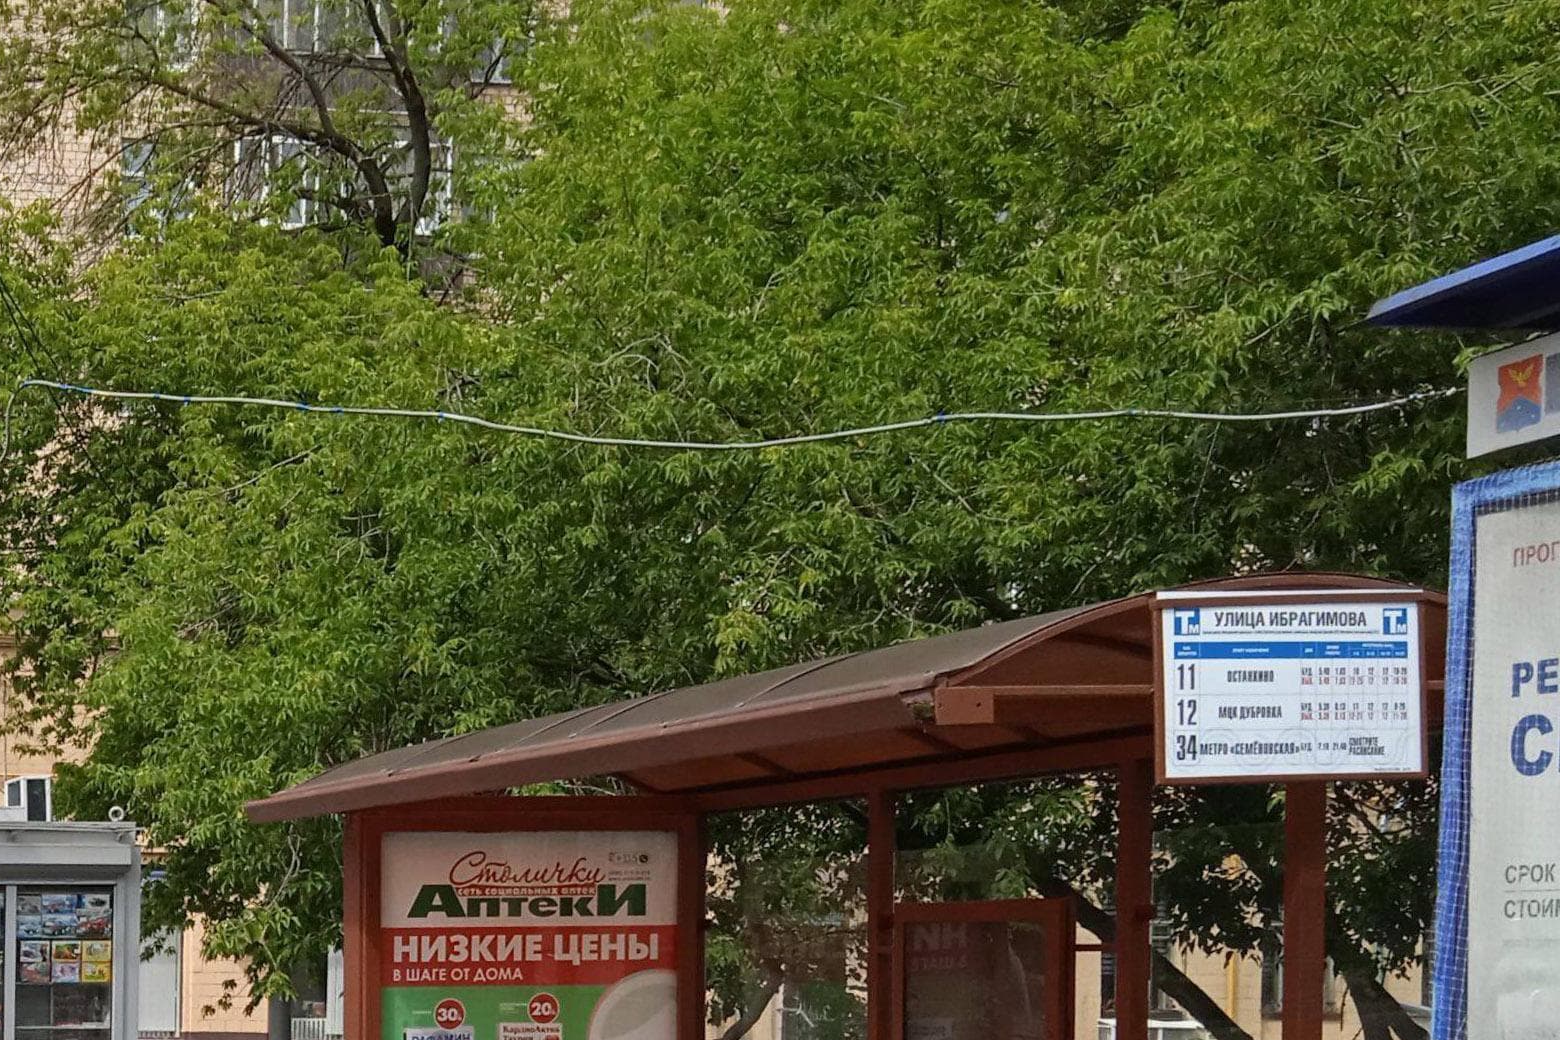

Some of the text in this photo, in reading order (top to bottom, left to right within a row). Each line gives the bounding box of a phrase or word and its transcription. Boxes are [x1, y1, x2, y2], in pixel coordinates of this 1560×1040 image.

[1214, 611, 1367, 630] УЛИЦА ИБРАГИМОВА
[1177, 663, 1195, 690] 11
[1227, 670, 1274, 682] ОСТАНКИНО
[1177, 699, 1197, 726] 12
[1218, 706, 1238, 720] МЦК
[1239, 705, 1282, 720] ДУБРОВКА
[1176, 734, 1197, 760] 34
[1200, 743, 1228, 756] МЕТРО
[449, 851, 607, 887] Столички
[1505, 863, 1556, 884] СРОК
[457, 886, 596, 896] сеть социальных аптек
[393, 933, 659, 966] НИЗКИЕ ЦЕНЫ
[393, 968, 523, 982] В ШАГЕ ОТ ДОМА
